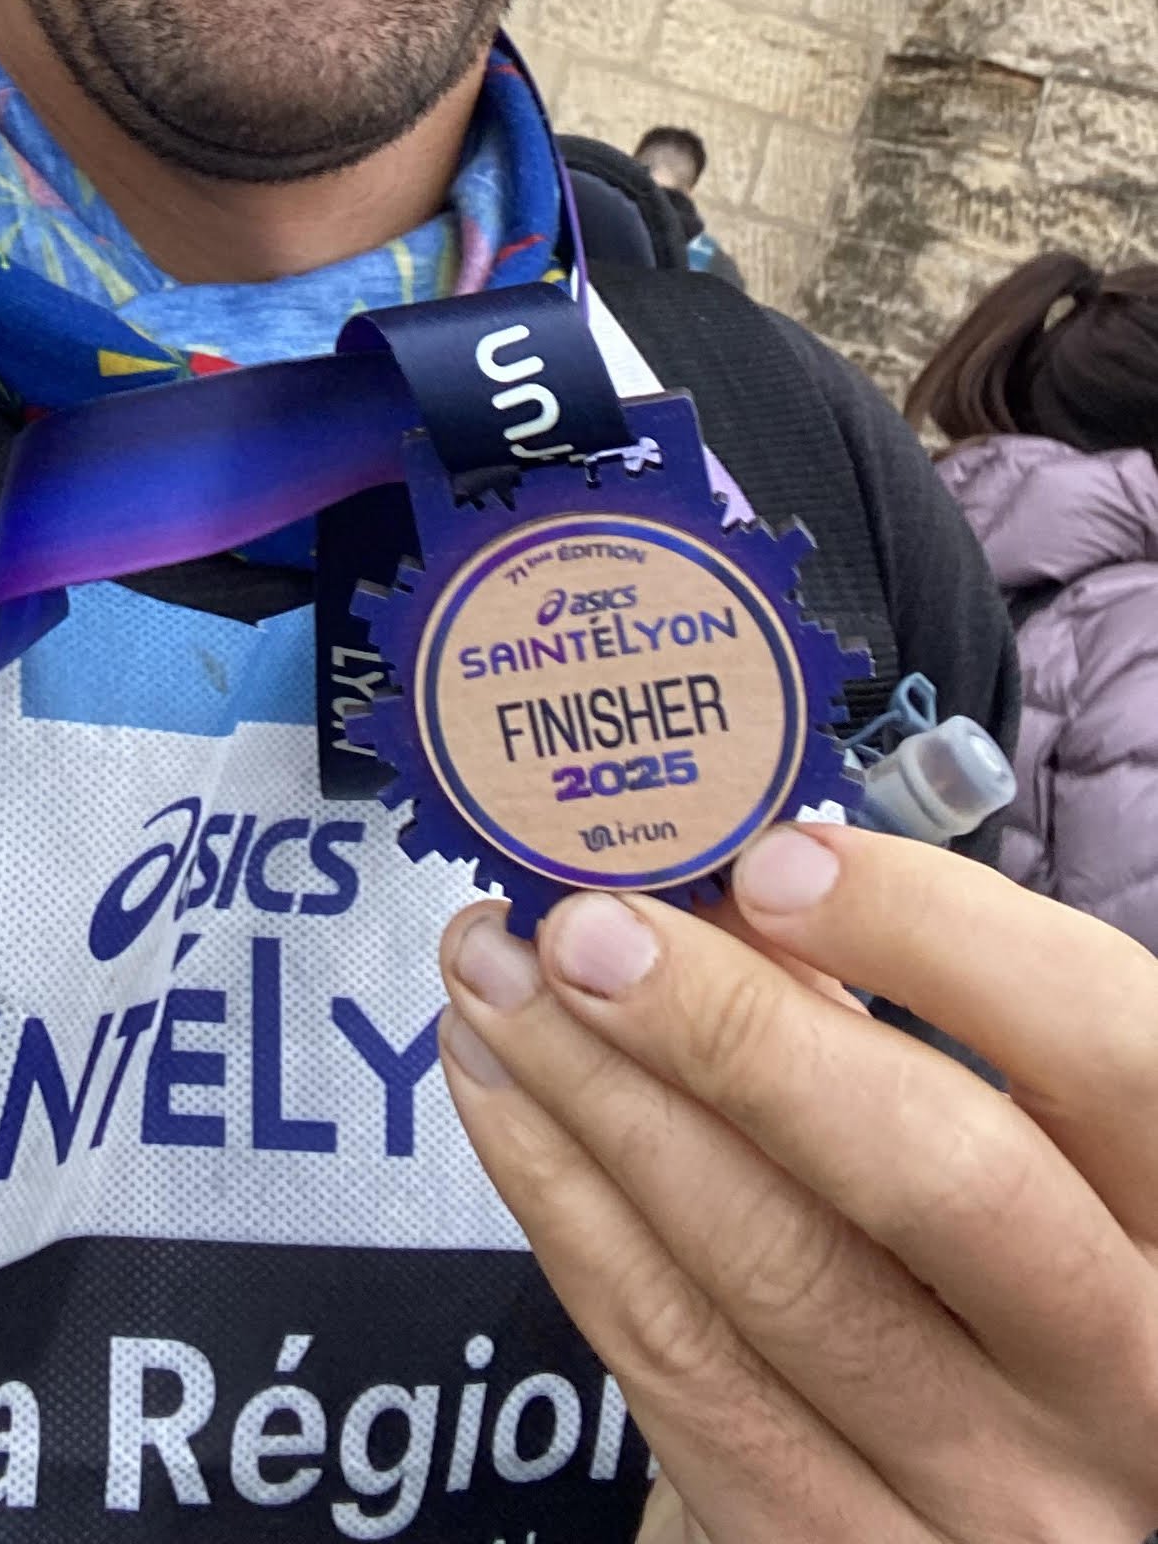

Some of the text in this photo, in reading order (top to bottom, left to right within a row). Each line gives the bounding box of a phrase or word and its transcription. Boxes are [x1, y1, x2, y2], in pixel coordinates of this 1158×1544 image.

[496, 673, 729, 762] FINISHER
[552, 750, 699, 802] 2025
[616, 820, 678, 845] i-run
